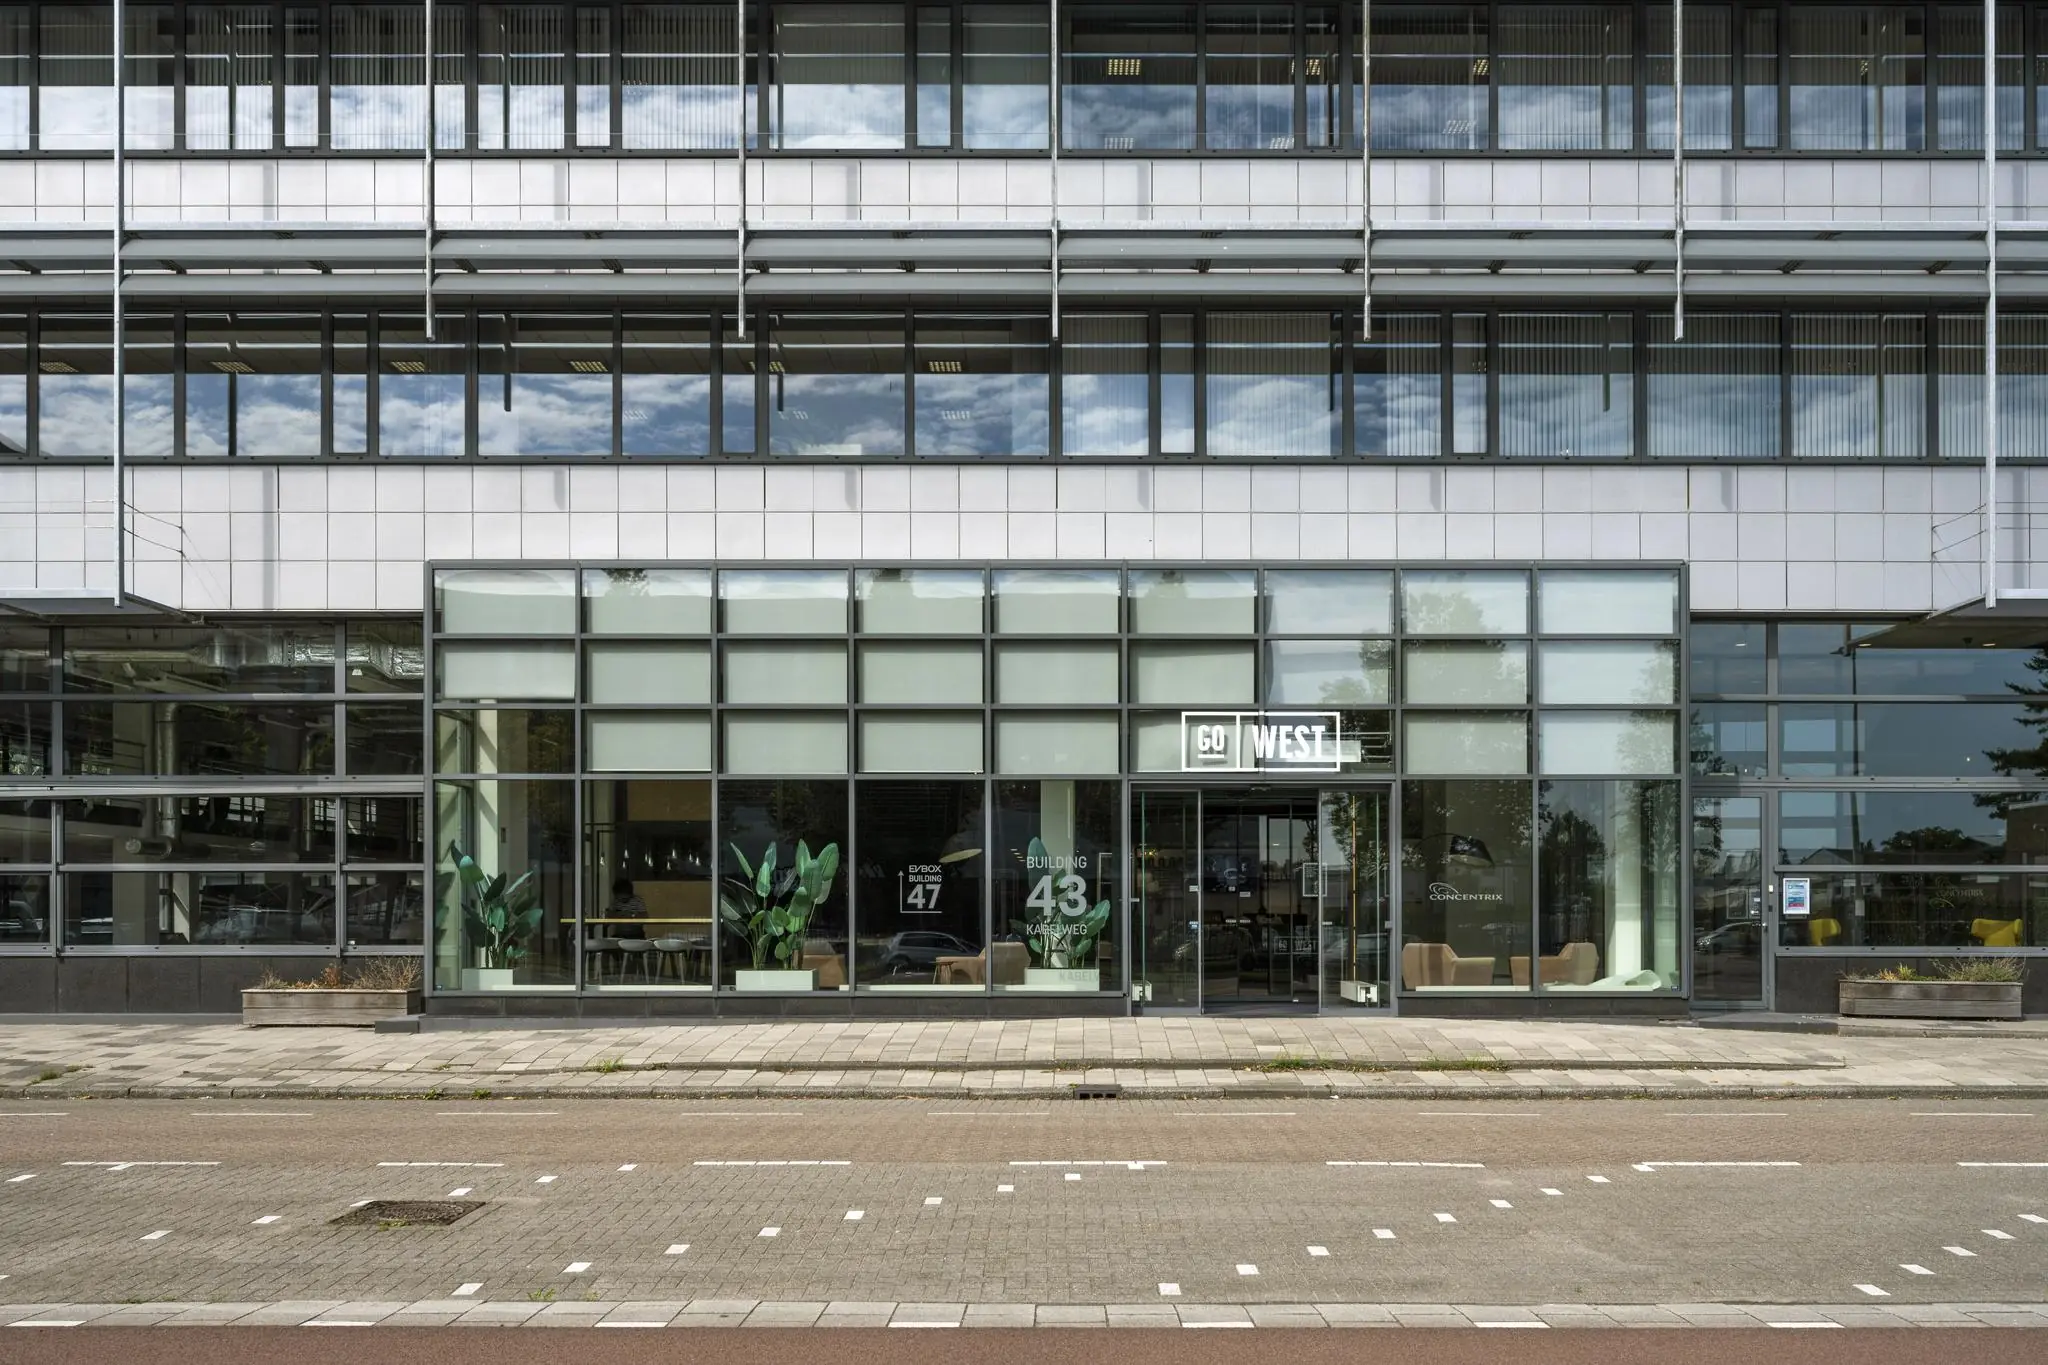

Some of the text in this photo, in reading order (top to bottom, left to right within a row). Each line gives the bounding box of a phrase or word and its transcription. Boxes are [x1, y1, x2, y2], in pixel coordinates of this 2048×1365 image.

[1197, 725, 1326, 759] GO WEST
[908, 864, 942, 873] EVBOX
[1026, 856, 1087, 869] BUILDING
[908, 874, 942, 882] BUILDING
[907, 884, 941, 909] 47
[1026, 875, 1087, 916] 43
[1429, 893, 1503, 901] CONCENTRIX
[1026, 923, 1087, 935] KABELWEG
